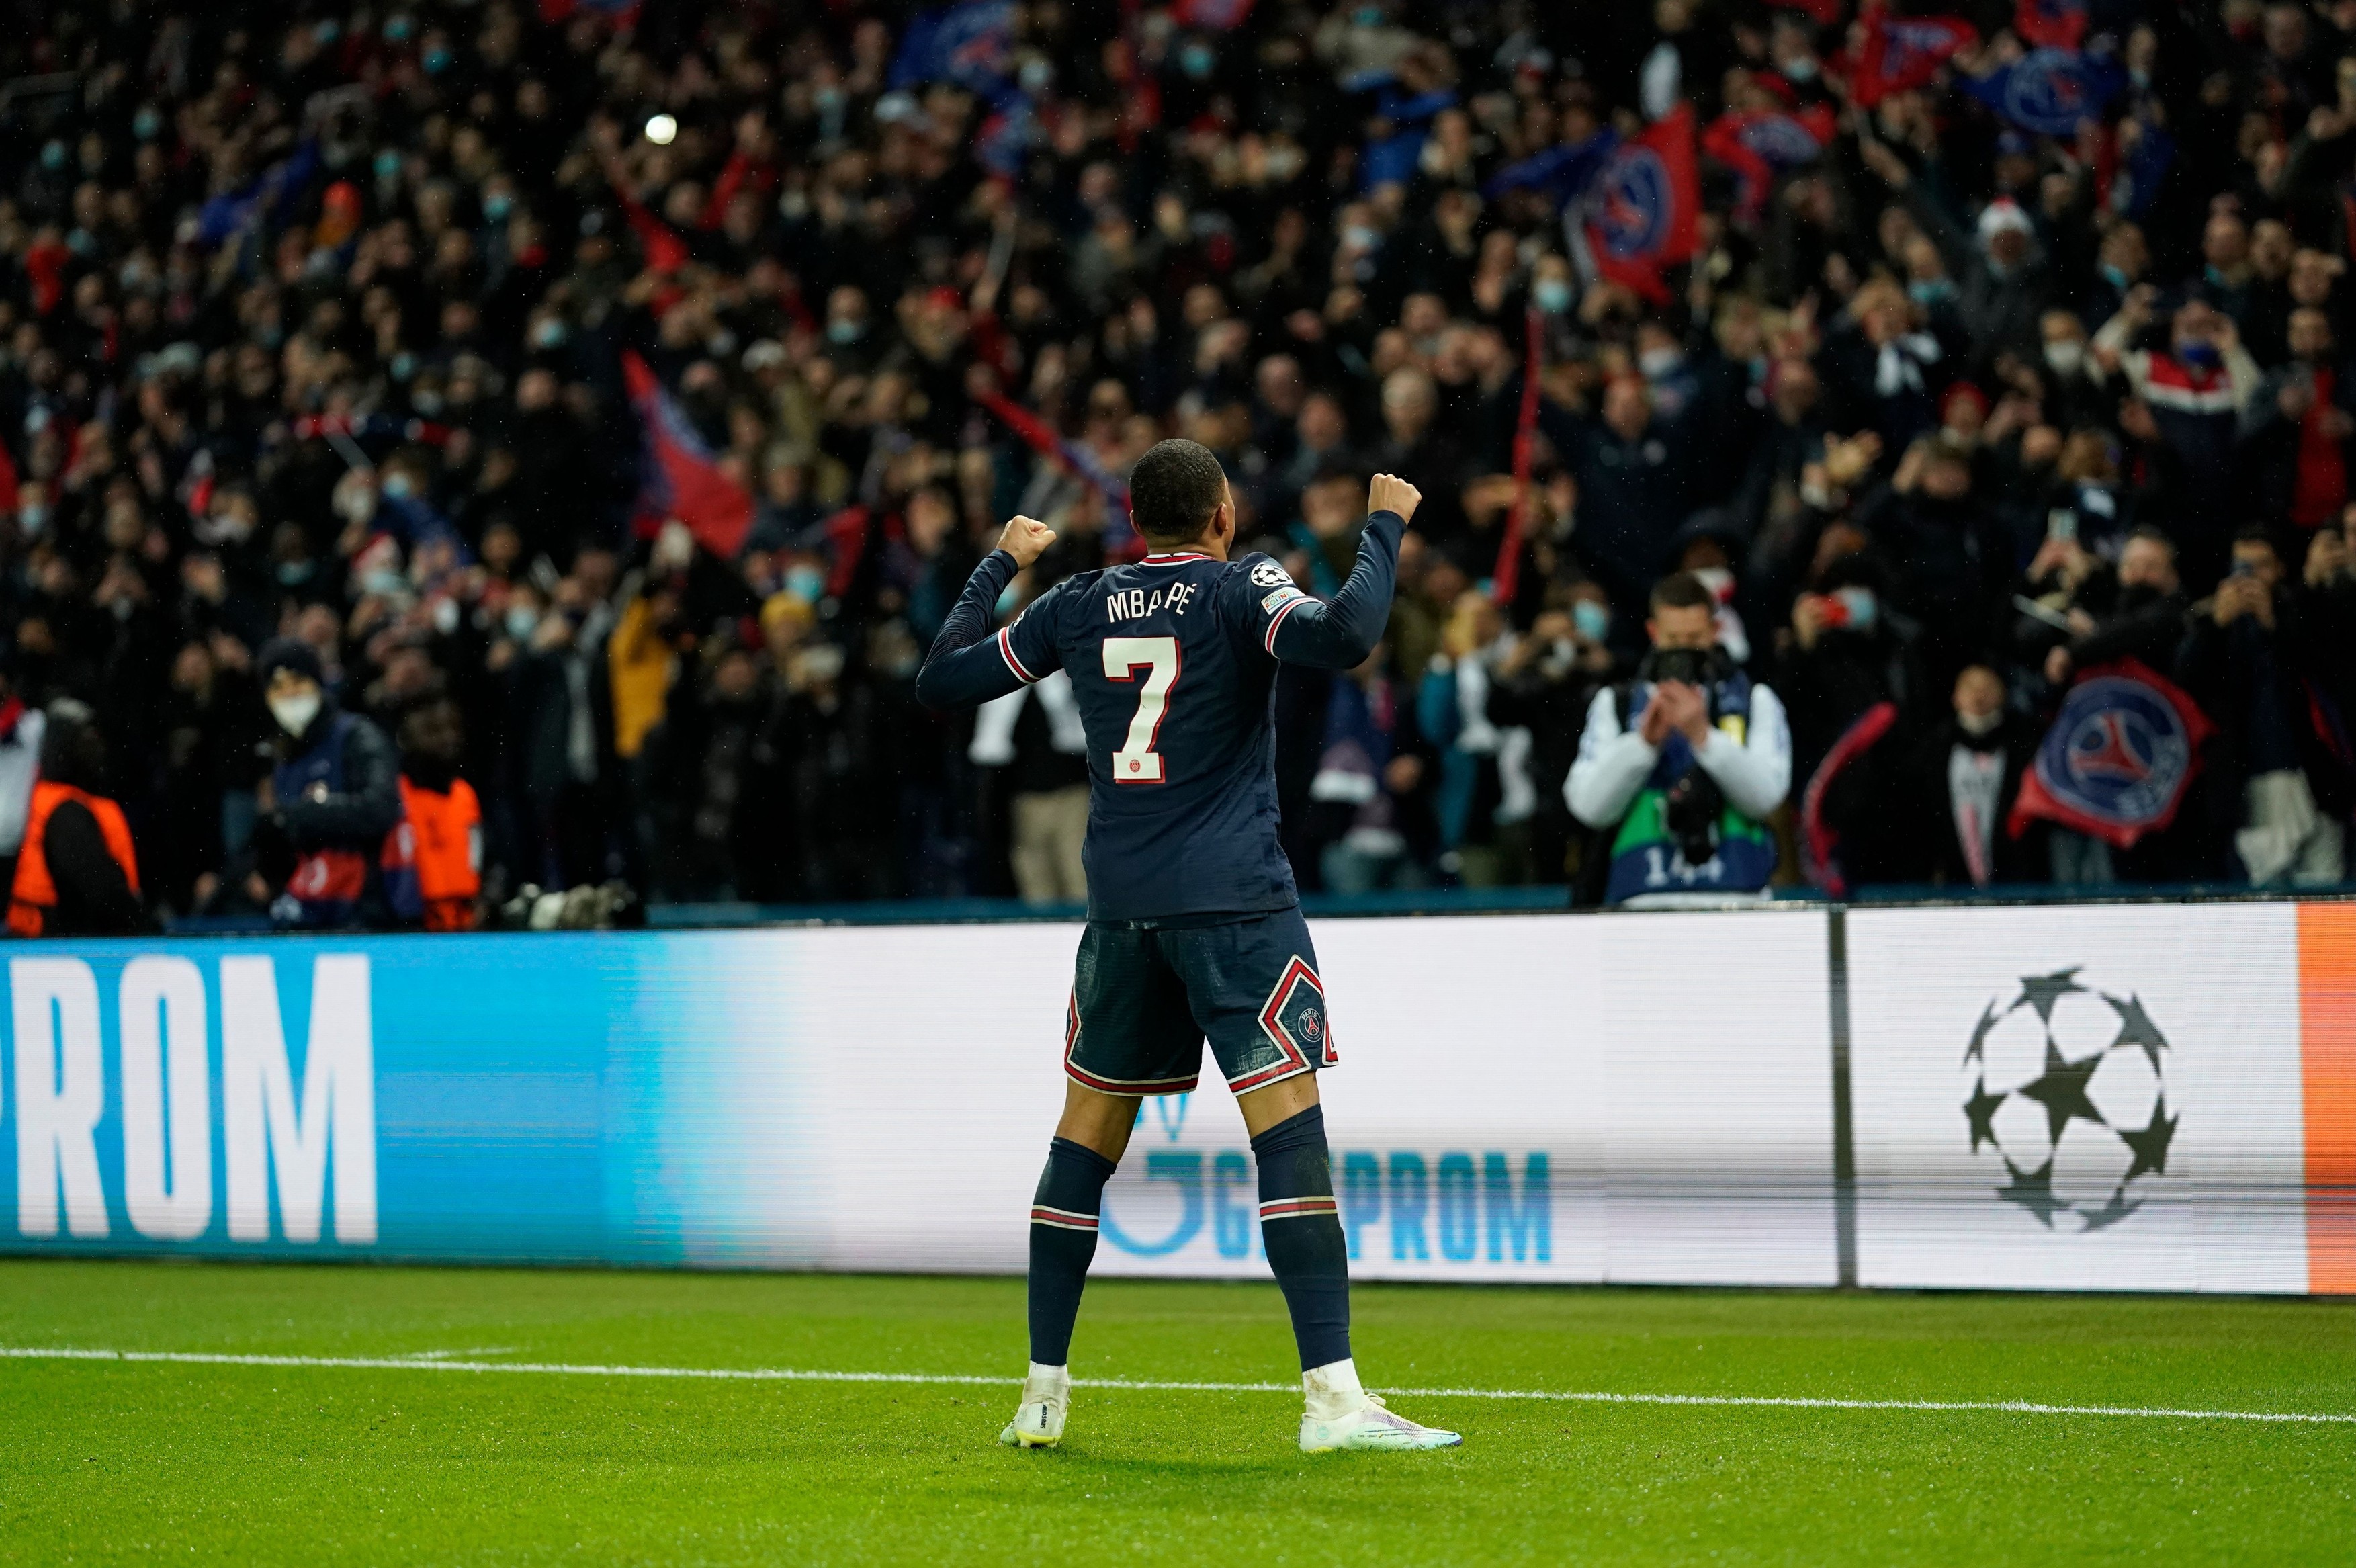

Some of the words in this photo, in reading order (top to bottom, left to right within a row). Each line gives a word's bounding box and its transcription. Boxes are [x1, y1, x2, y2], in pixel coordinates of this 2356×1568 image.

[1107, 582, 1197, 623] MBAPÉ
[1102, 636, 1182, 785] 7
[1301, 1010, 1317, 1020] PARIS
[0, 954, 378, 1243] ROM
[1214, 1151, 1551, 1263] GPROM
